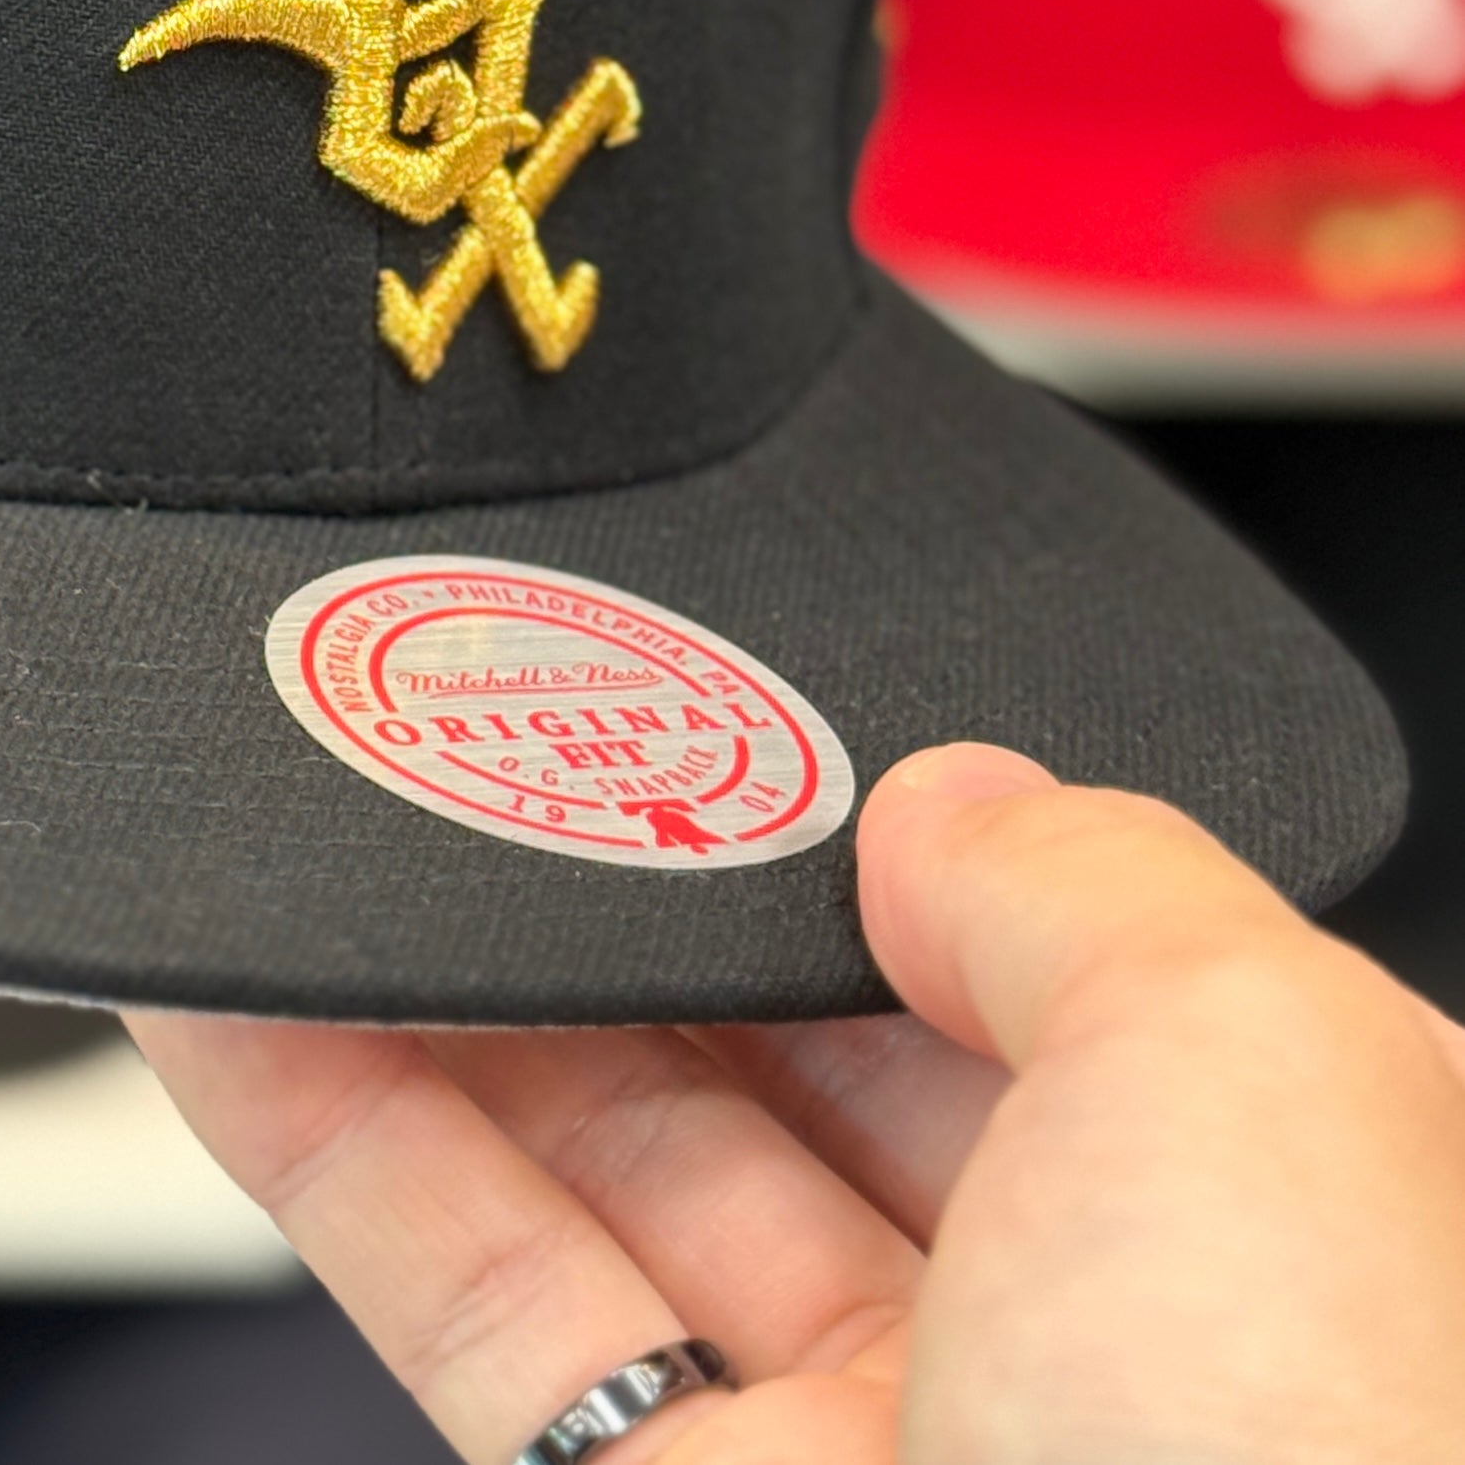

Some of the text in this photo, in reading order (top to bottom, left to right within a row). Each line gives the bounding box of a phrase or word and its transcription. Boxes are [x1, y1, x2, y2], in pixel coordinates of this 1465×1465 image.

[325, 583, 742, 714] NOSTALGIA CO. PHILADELPHIA, PA
[395, 661, 658, 694] Mitchell & Ness
[372, 701, 773, 747] ORIGINAL
[548, 739, 653, 770] FIT
[593, 744, 719, 797] SNAPBACK
[508, 781, 788, 824] 19 04
